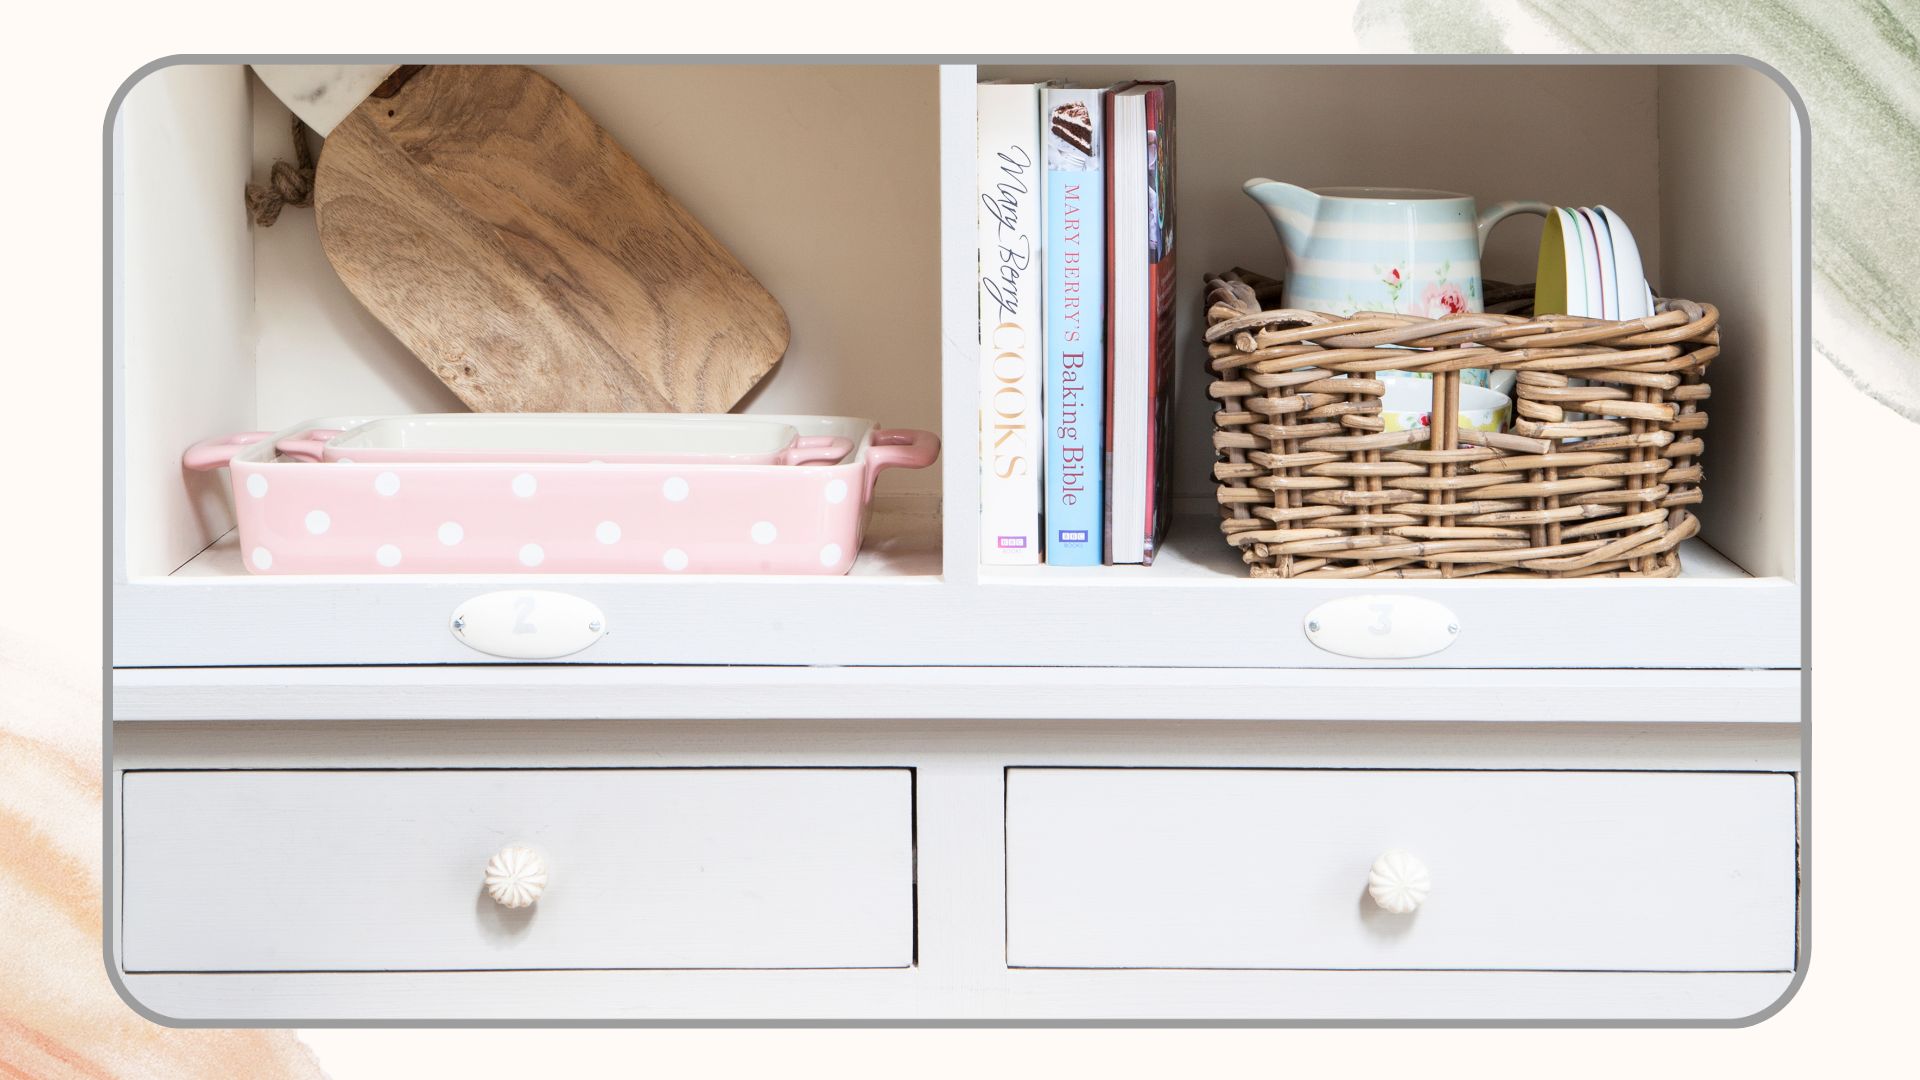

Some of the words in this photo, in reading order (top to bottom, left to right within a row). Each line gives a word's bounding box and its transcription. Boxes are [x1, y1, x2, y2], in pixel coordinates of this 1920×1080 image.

[981, 145, 1031, 242] Mary
[1064, 184, 1080, 245] MARY
[983, 234, 1030, 322] Berry
[1064, 252, 1080, 342] BERRY'S
[993, 322, 1027, 479] COOKS
[1057, 351, 1084, 439] Baking
[1062, 445, 1084, 506] Bible
[513, 597, 537, 634] 2
[1368, 604, 1393, 635] 3
